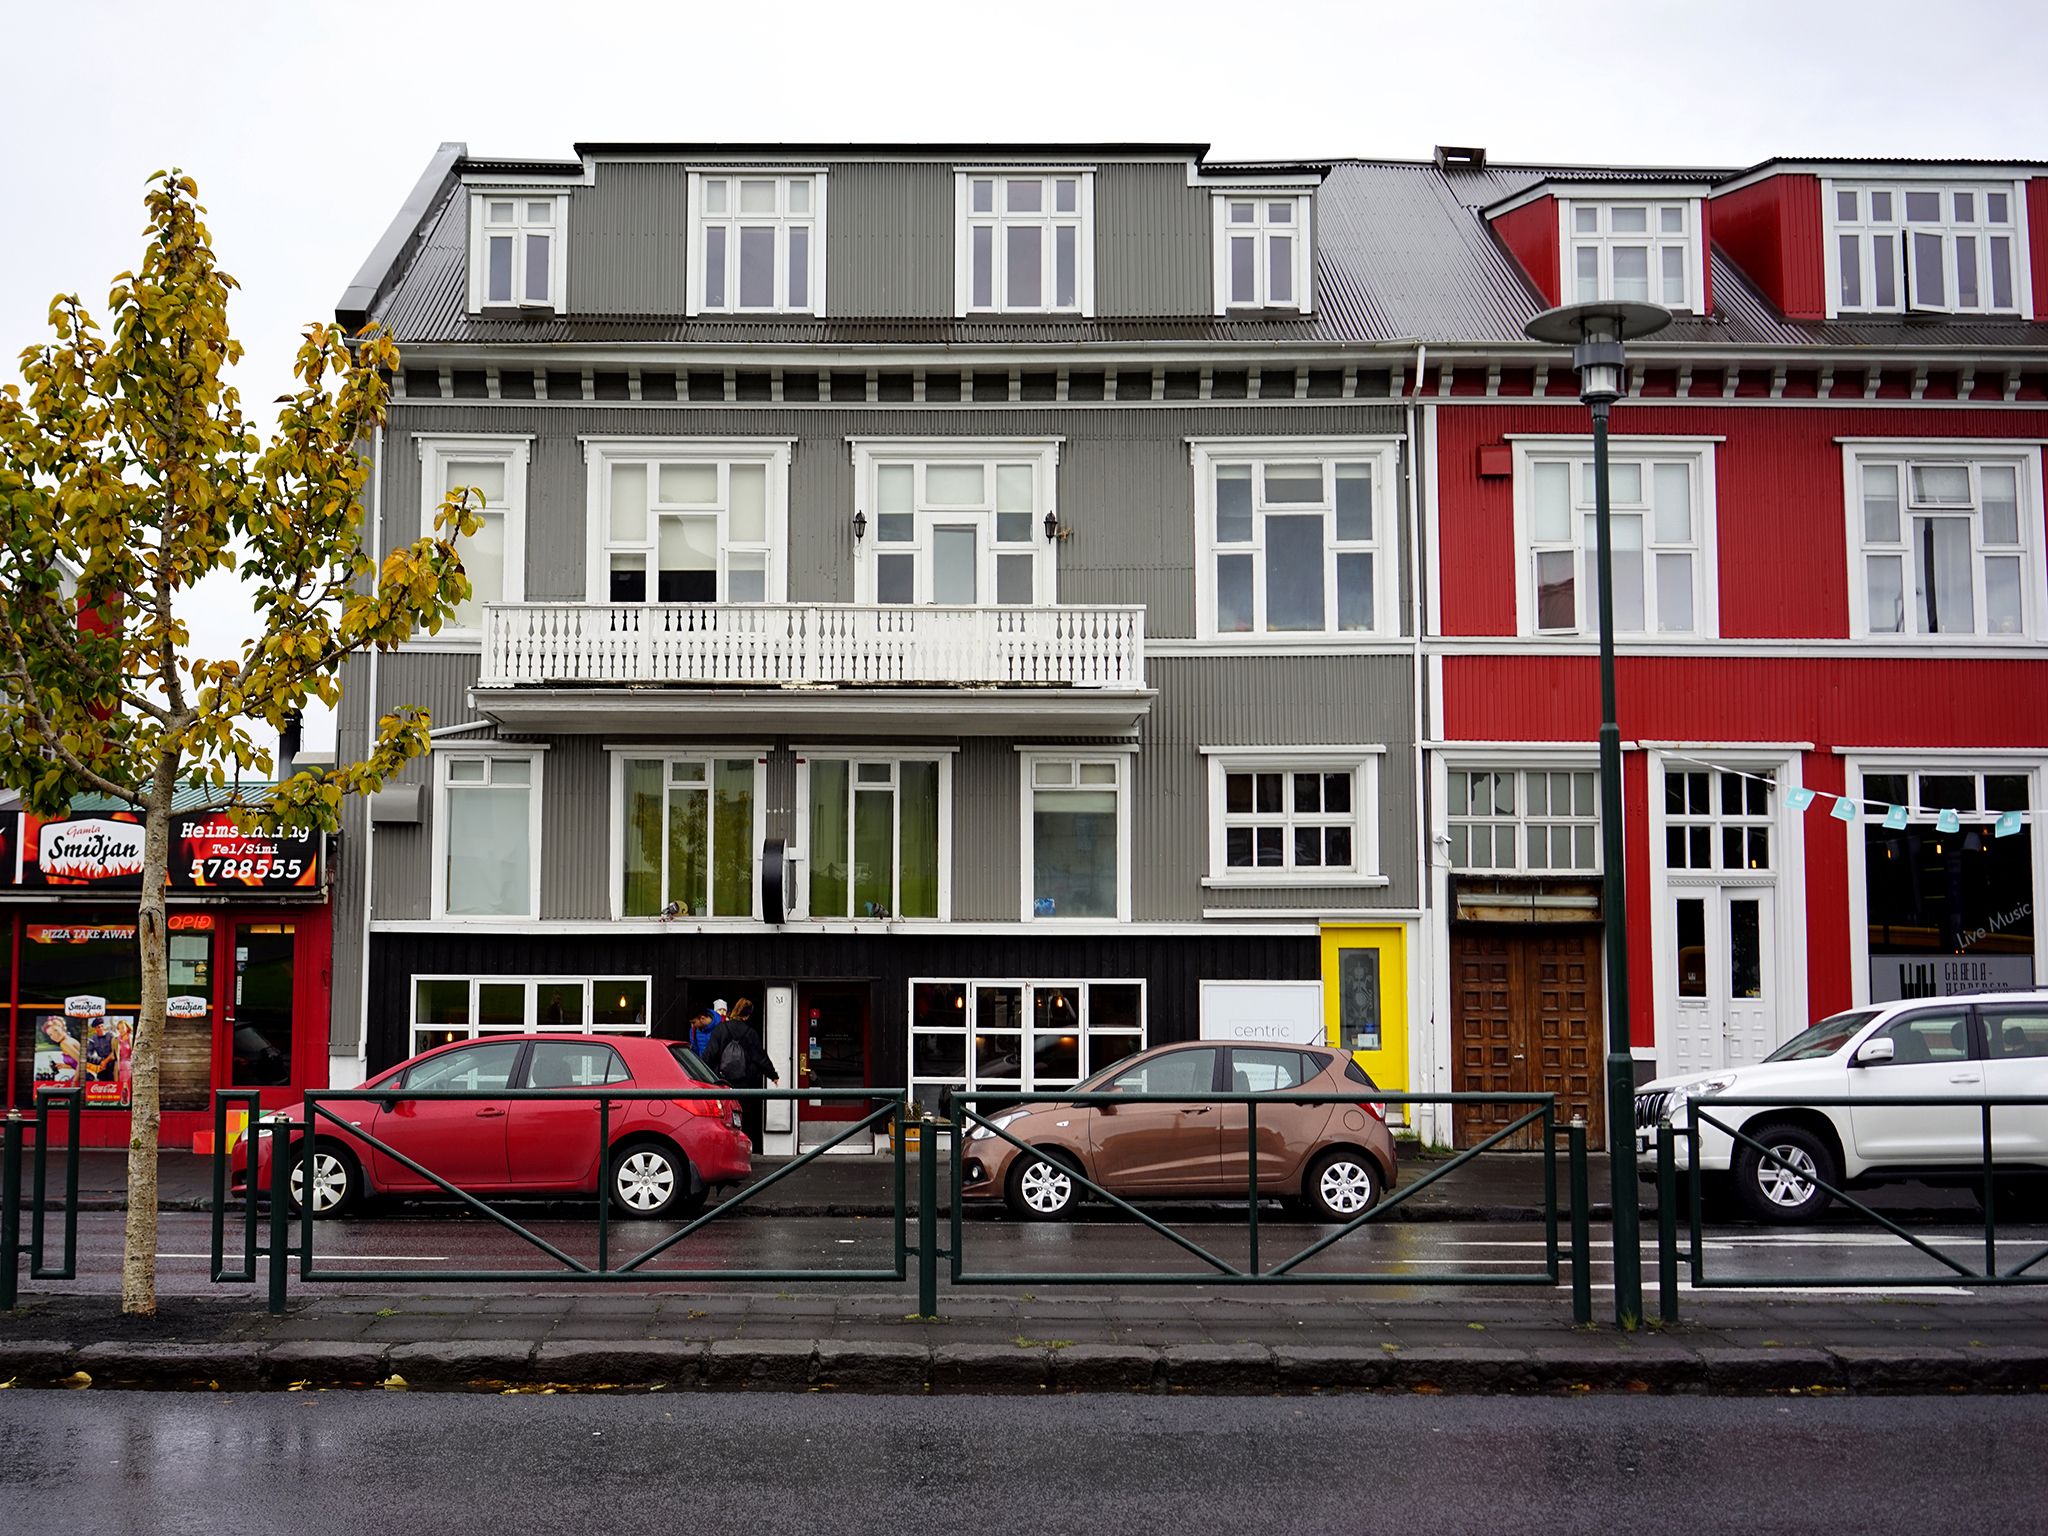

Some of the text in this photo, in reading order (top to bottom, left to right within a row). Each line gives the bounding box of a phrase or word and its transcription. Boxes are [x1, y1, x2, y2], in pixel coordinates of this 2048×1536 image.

[66, 825, 102, 838] Gamla
[180, 822, 309, 843] Heimsning
[48, 834, 139, 866] Smiðjan
[212, 843, 279, 855] Tel/Sími
[188, 859, 302, 879] 5788555
[1956, 902, 2032, 949] Live Music
[41, 928, 135, 939] PIZZA TAKE AWAY
[68, 1001, 102, 1013] Smiðjan
[169, 1001, 203, 1013] Smiðjan
[1234, 1024, 1290, 1037] centric
